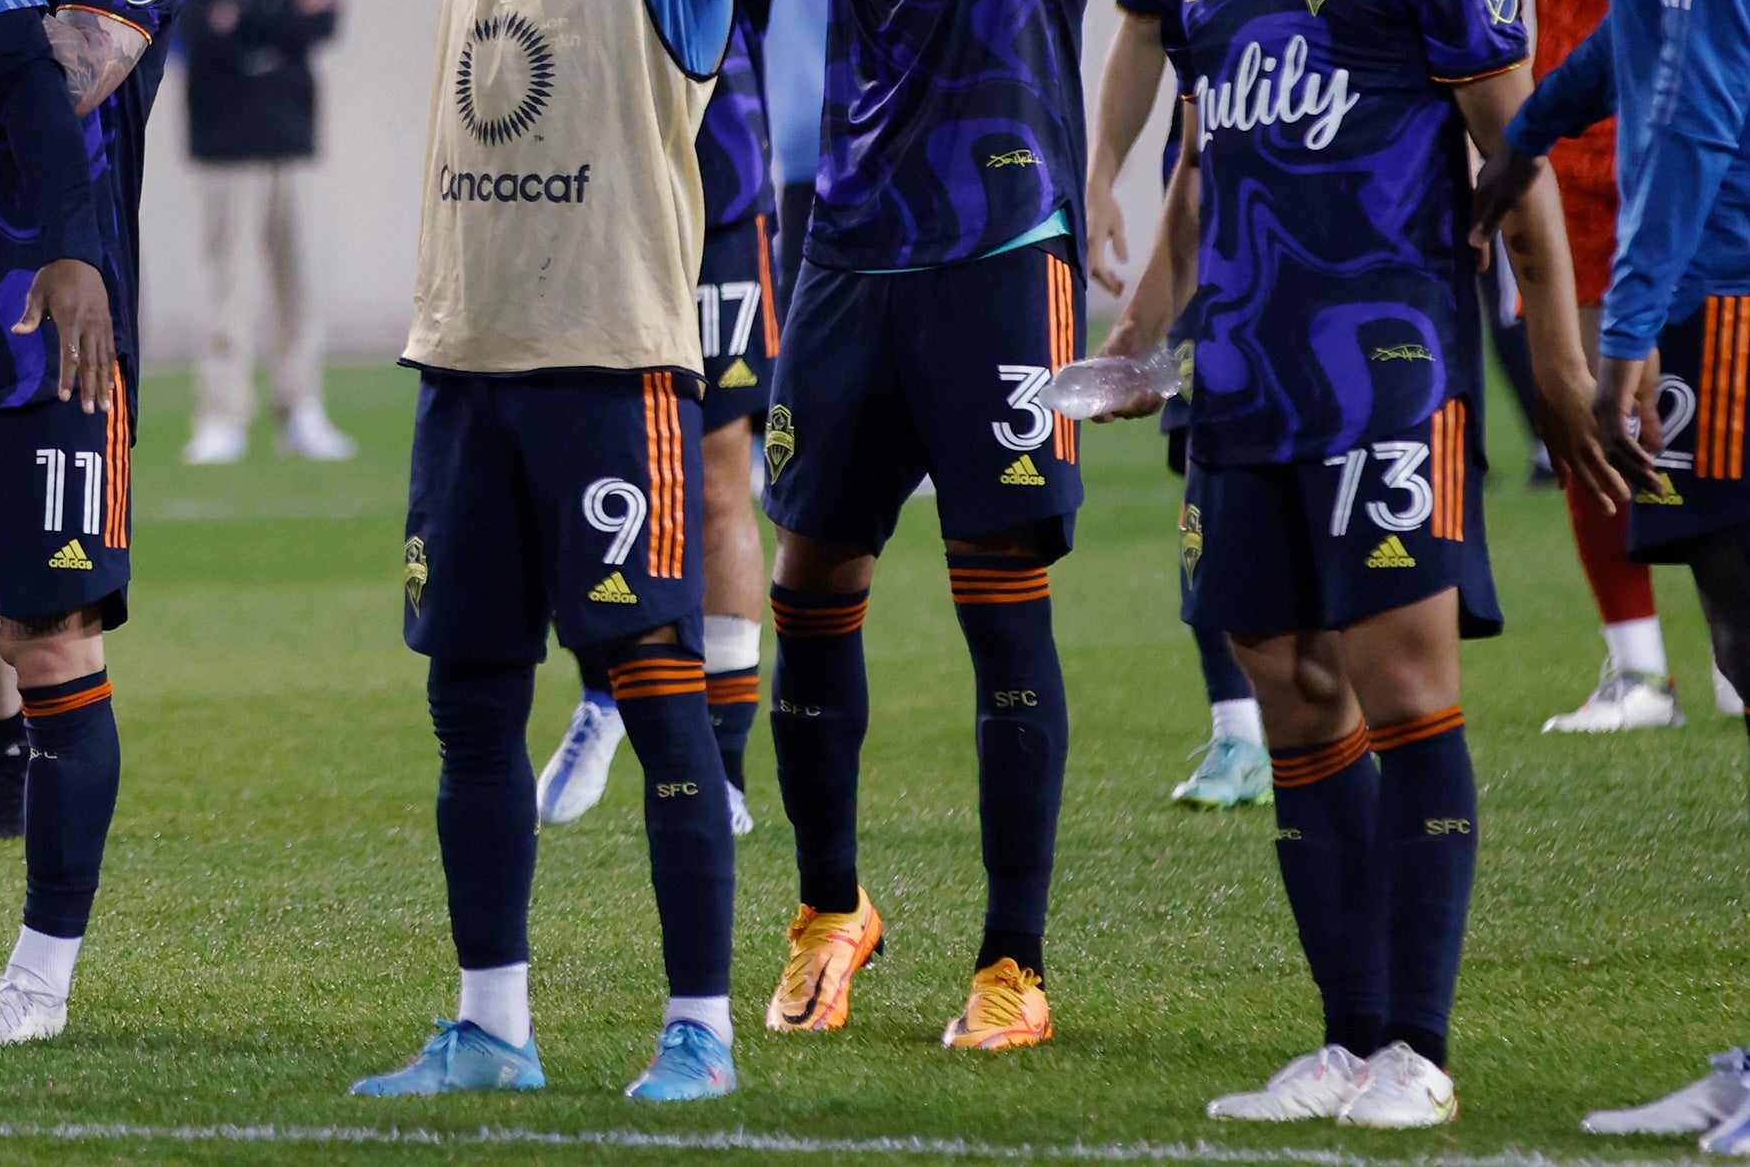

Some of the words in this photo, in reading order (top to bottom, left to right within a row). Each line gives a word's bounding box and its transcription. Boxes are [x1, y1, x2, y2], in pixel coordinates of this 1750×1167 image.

[696, 281, 761, 358] 17
[991, 364, 1054, 451] 3
[1623, 373, 1696, 470] 2
[1000, 472, 1046, 486] adidas
[1323, 440, 1434, 537] 73
[36, 448, 102, 535] 11
[582, 477, 647, 565] 9
[48, 557, 93, 570] adidas
[1365, 556, 1416, 568] adidas
[588, 590, 637, 604] adidas
[995, 689, 1038, 708] SFC
[656, 782, 699, 798] SFC
[1426, 818, 1471, 835] SFC
